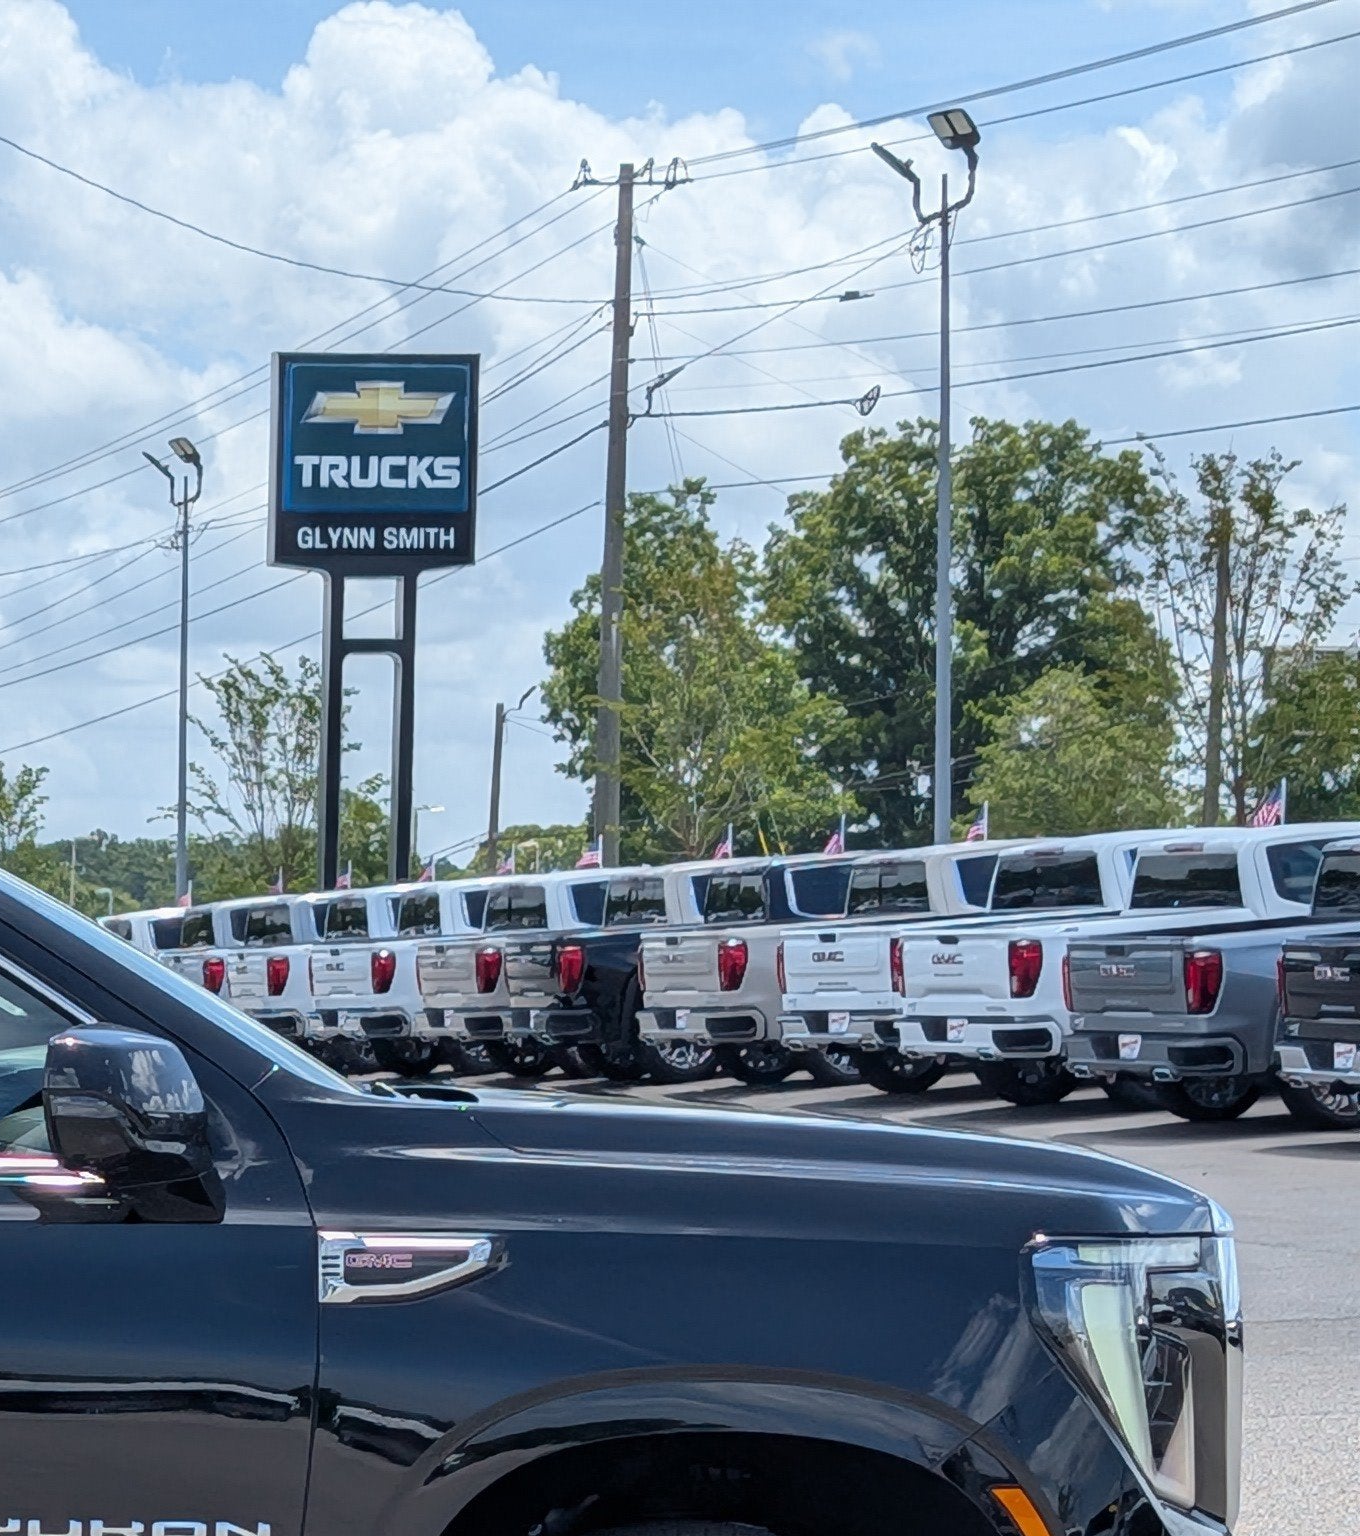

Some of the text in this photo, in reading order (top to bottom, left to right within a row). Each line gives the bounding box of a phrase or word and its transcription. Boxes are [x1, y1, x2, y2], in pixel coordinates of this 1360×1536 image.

[293, 455, 461, 489] TRUCKS
[296, 525, 455, 550] GLYNN SMITH
[345, 1253, 413, 1268] GMC
